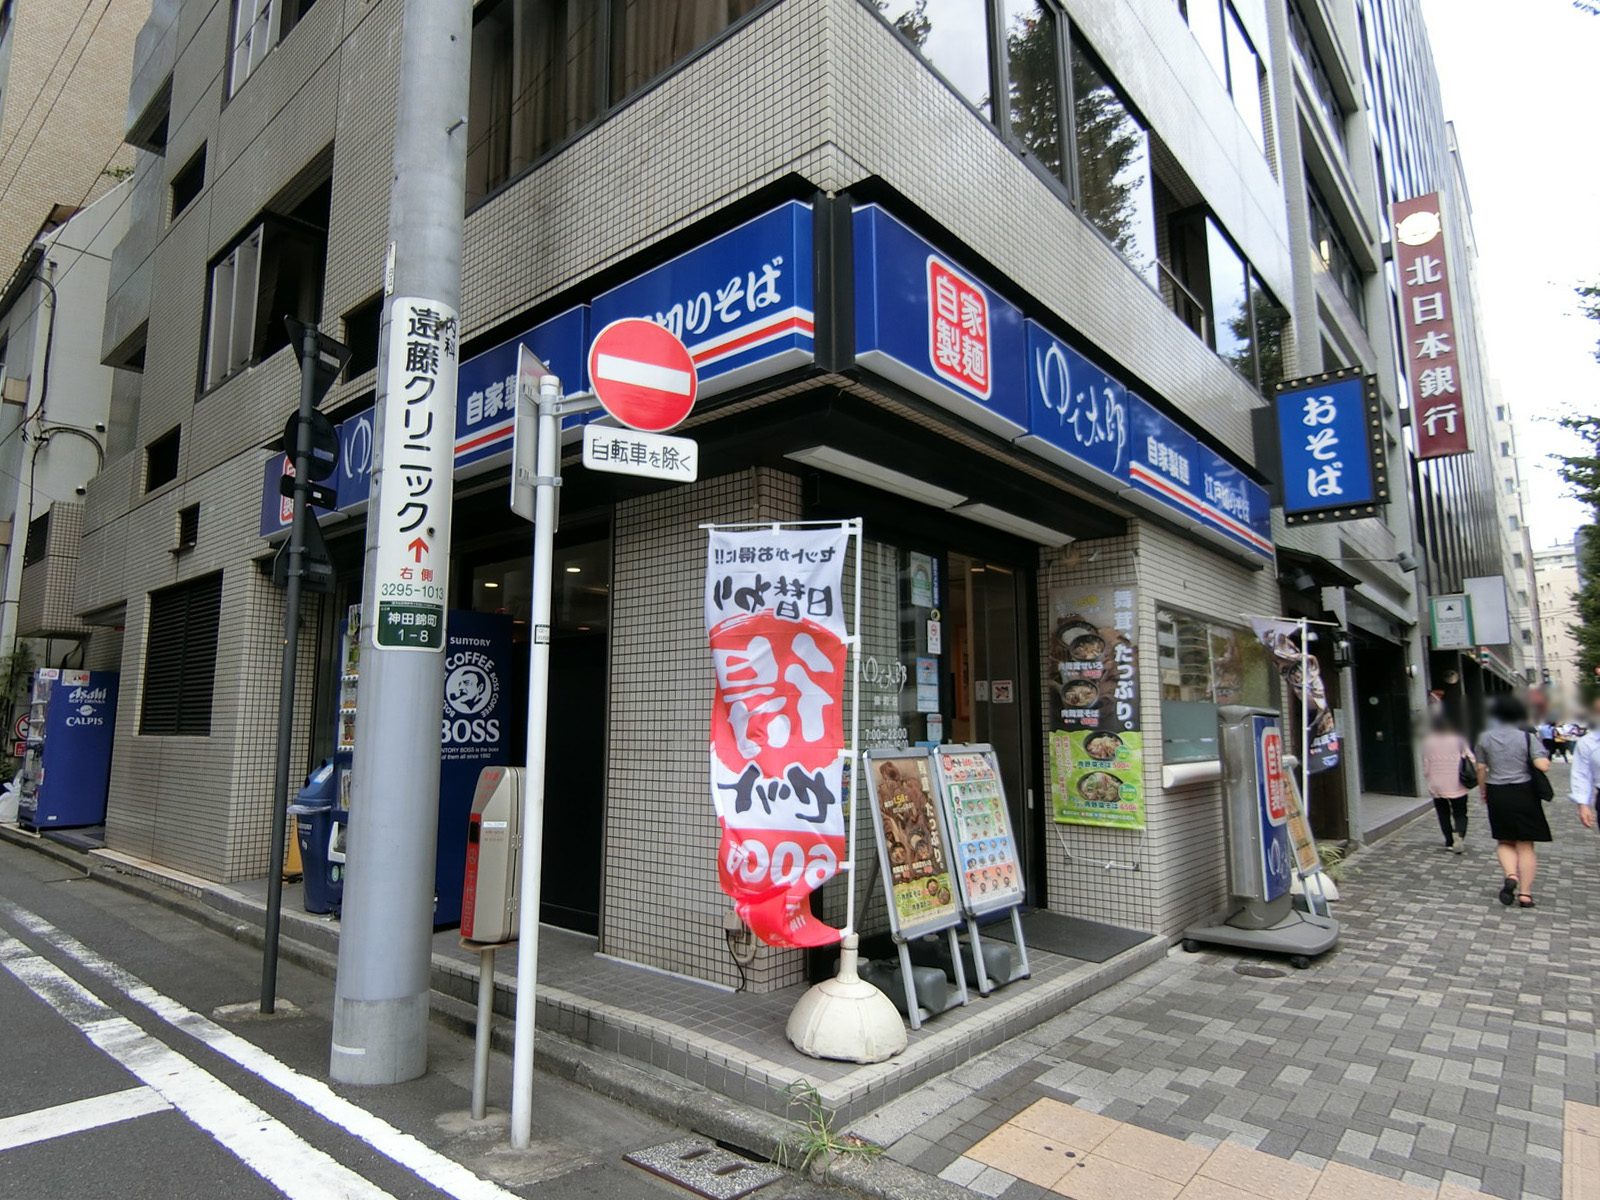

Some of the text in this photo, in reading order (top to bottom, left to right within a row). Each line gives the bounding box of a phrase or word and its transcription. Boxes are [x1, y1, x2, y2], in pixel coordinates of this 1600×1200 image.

[645, 255, 784, 340] 切りそば
[936, 276, 984, 337] 自家
[445, 317, 457, 360] 内科
[936, 319, 986, 386] 製麺
[1406, 256, 1458, 437] 北日本銀行
[397, 306, 440, 533] 遠藤クリニック
[1036, 341, 1126, 472] ゆで太郎
[592, 438, 691, 472] 自転車を除く
[1146, 435, 1190, 486] 自家製麺
[1302, 395, 1343, 498] おそば
[381, 582, 444, 600] 3295-1013
[400, 567, 434, 582] 右側
[387, 611, 438, 627] 神田錦町
[398, 628, 429, 643] 1-8
[445, 651, 495, 672] COFFEE
[69, 687, 107, 699] Asahi
[481, 672, 500, 718] BOSS COFFEE
[66, 716, 104, 727] CALPIS
[441, 718, 500, 744] BOSS
